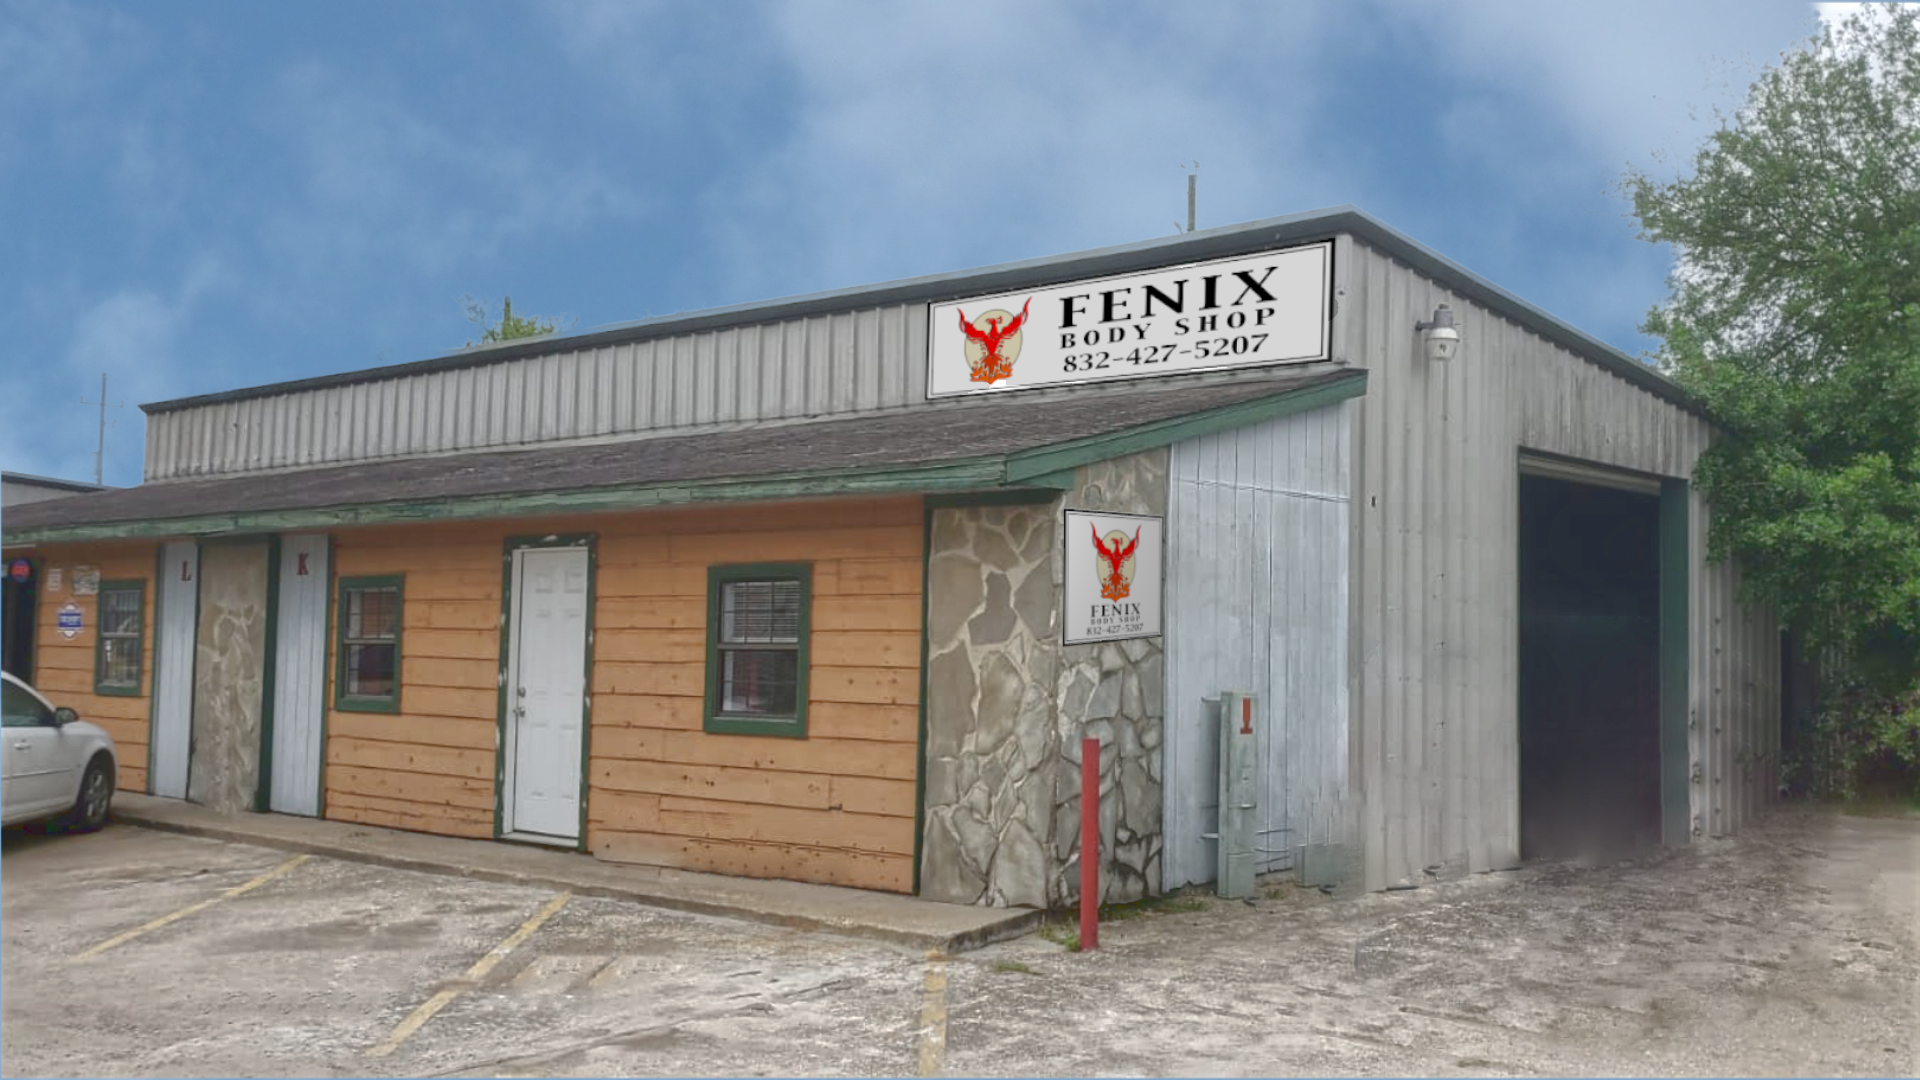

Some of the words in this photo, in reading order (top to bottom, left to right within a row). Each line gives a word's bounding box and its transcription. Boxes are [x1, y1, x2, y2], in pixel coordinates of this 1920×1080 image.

[1058, 266, 1279, 329] FENIX
[1060, 323, 1152, 349] BODY
[1174, 307, 1276, 336] SHOP
[1062, 333, 1270, 373] 832-427-5207
[181, 560, 192, 582] L
[296, 553, 309, 576] K
[1091, 603, 1140, 617] FENIX
[1091, 617, 1113, 625] BODY
[1087, 624, 1144, 635] 832-427-5207
